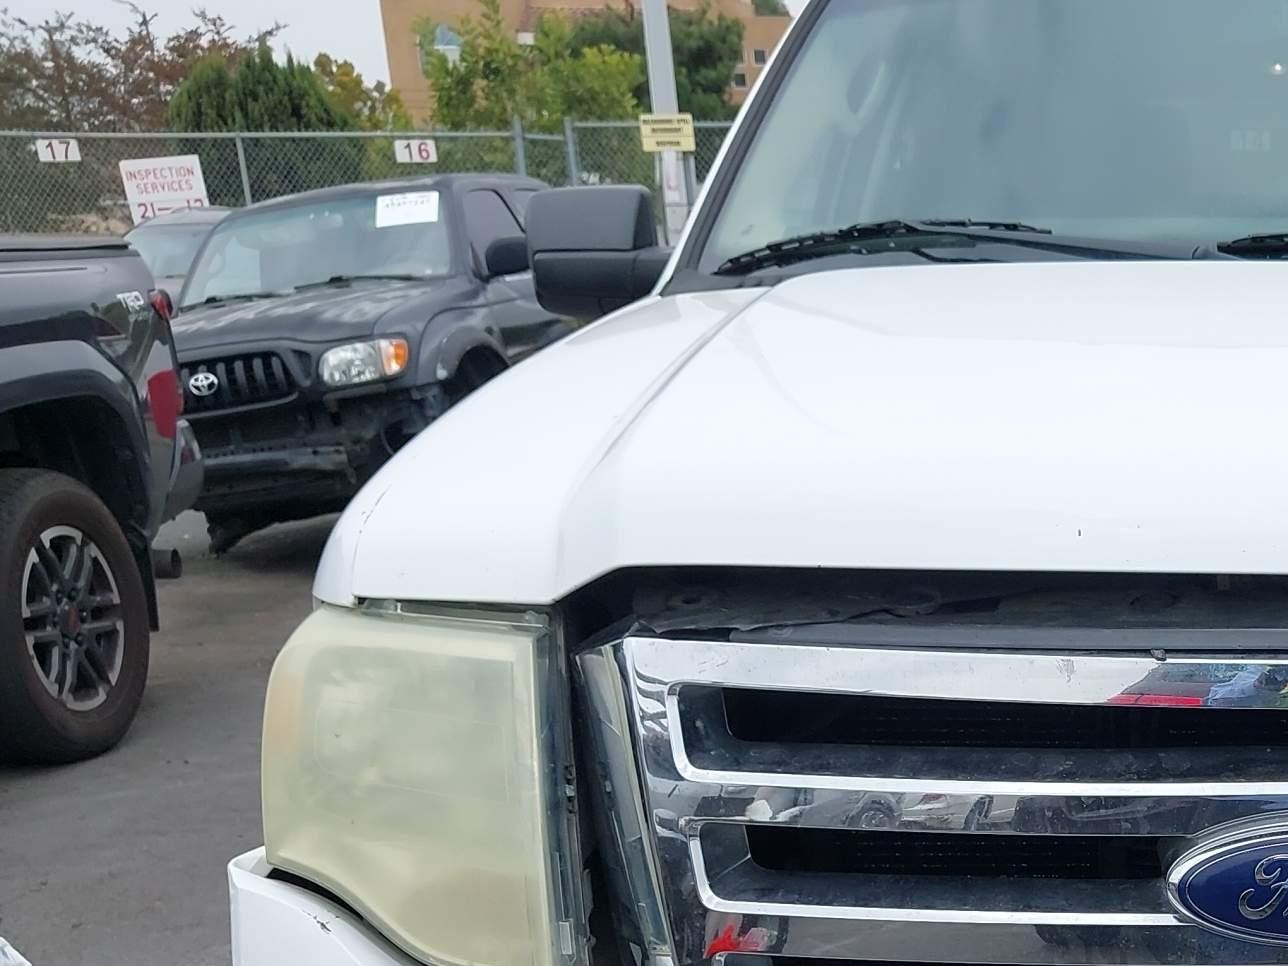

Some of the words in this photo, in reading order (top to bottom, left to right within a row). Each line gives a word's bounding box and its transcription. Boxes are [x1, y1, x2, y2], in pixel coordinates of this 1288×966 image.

[45, 141, 71, 160] 17
[404, 142, 430, 160] 16
[125, 165, 195, 182] INSPECTION
[136, 179, 193, 194] SERVICES
